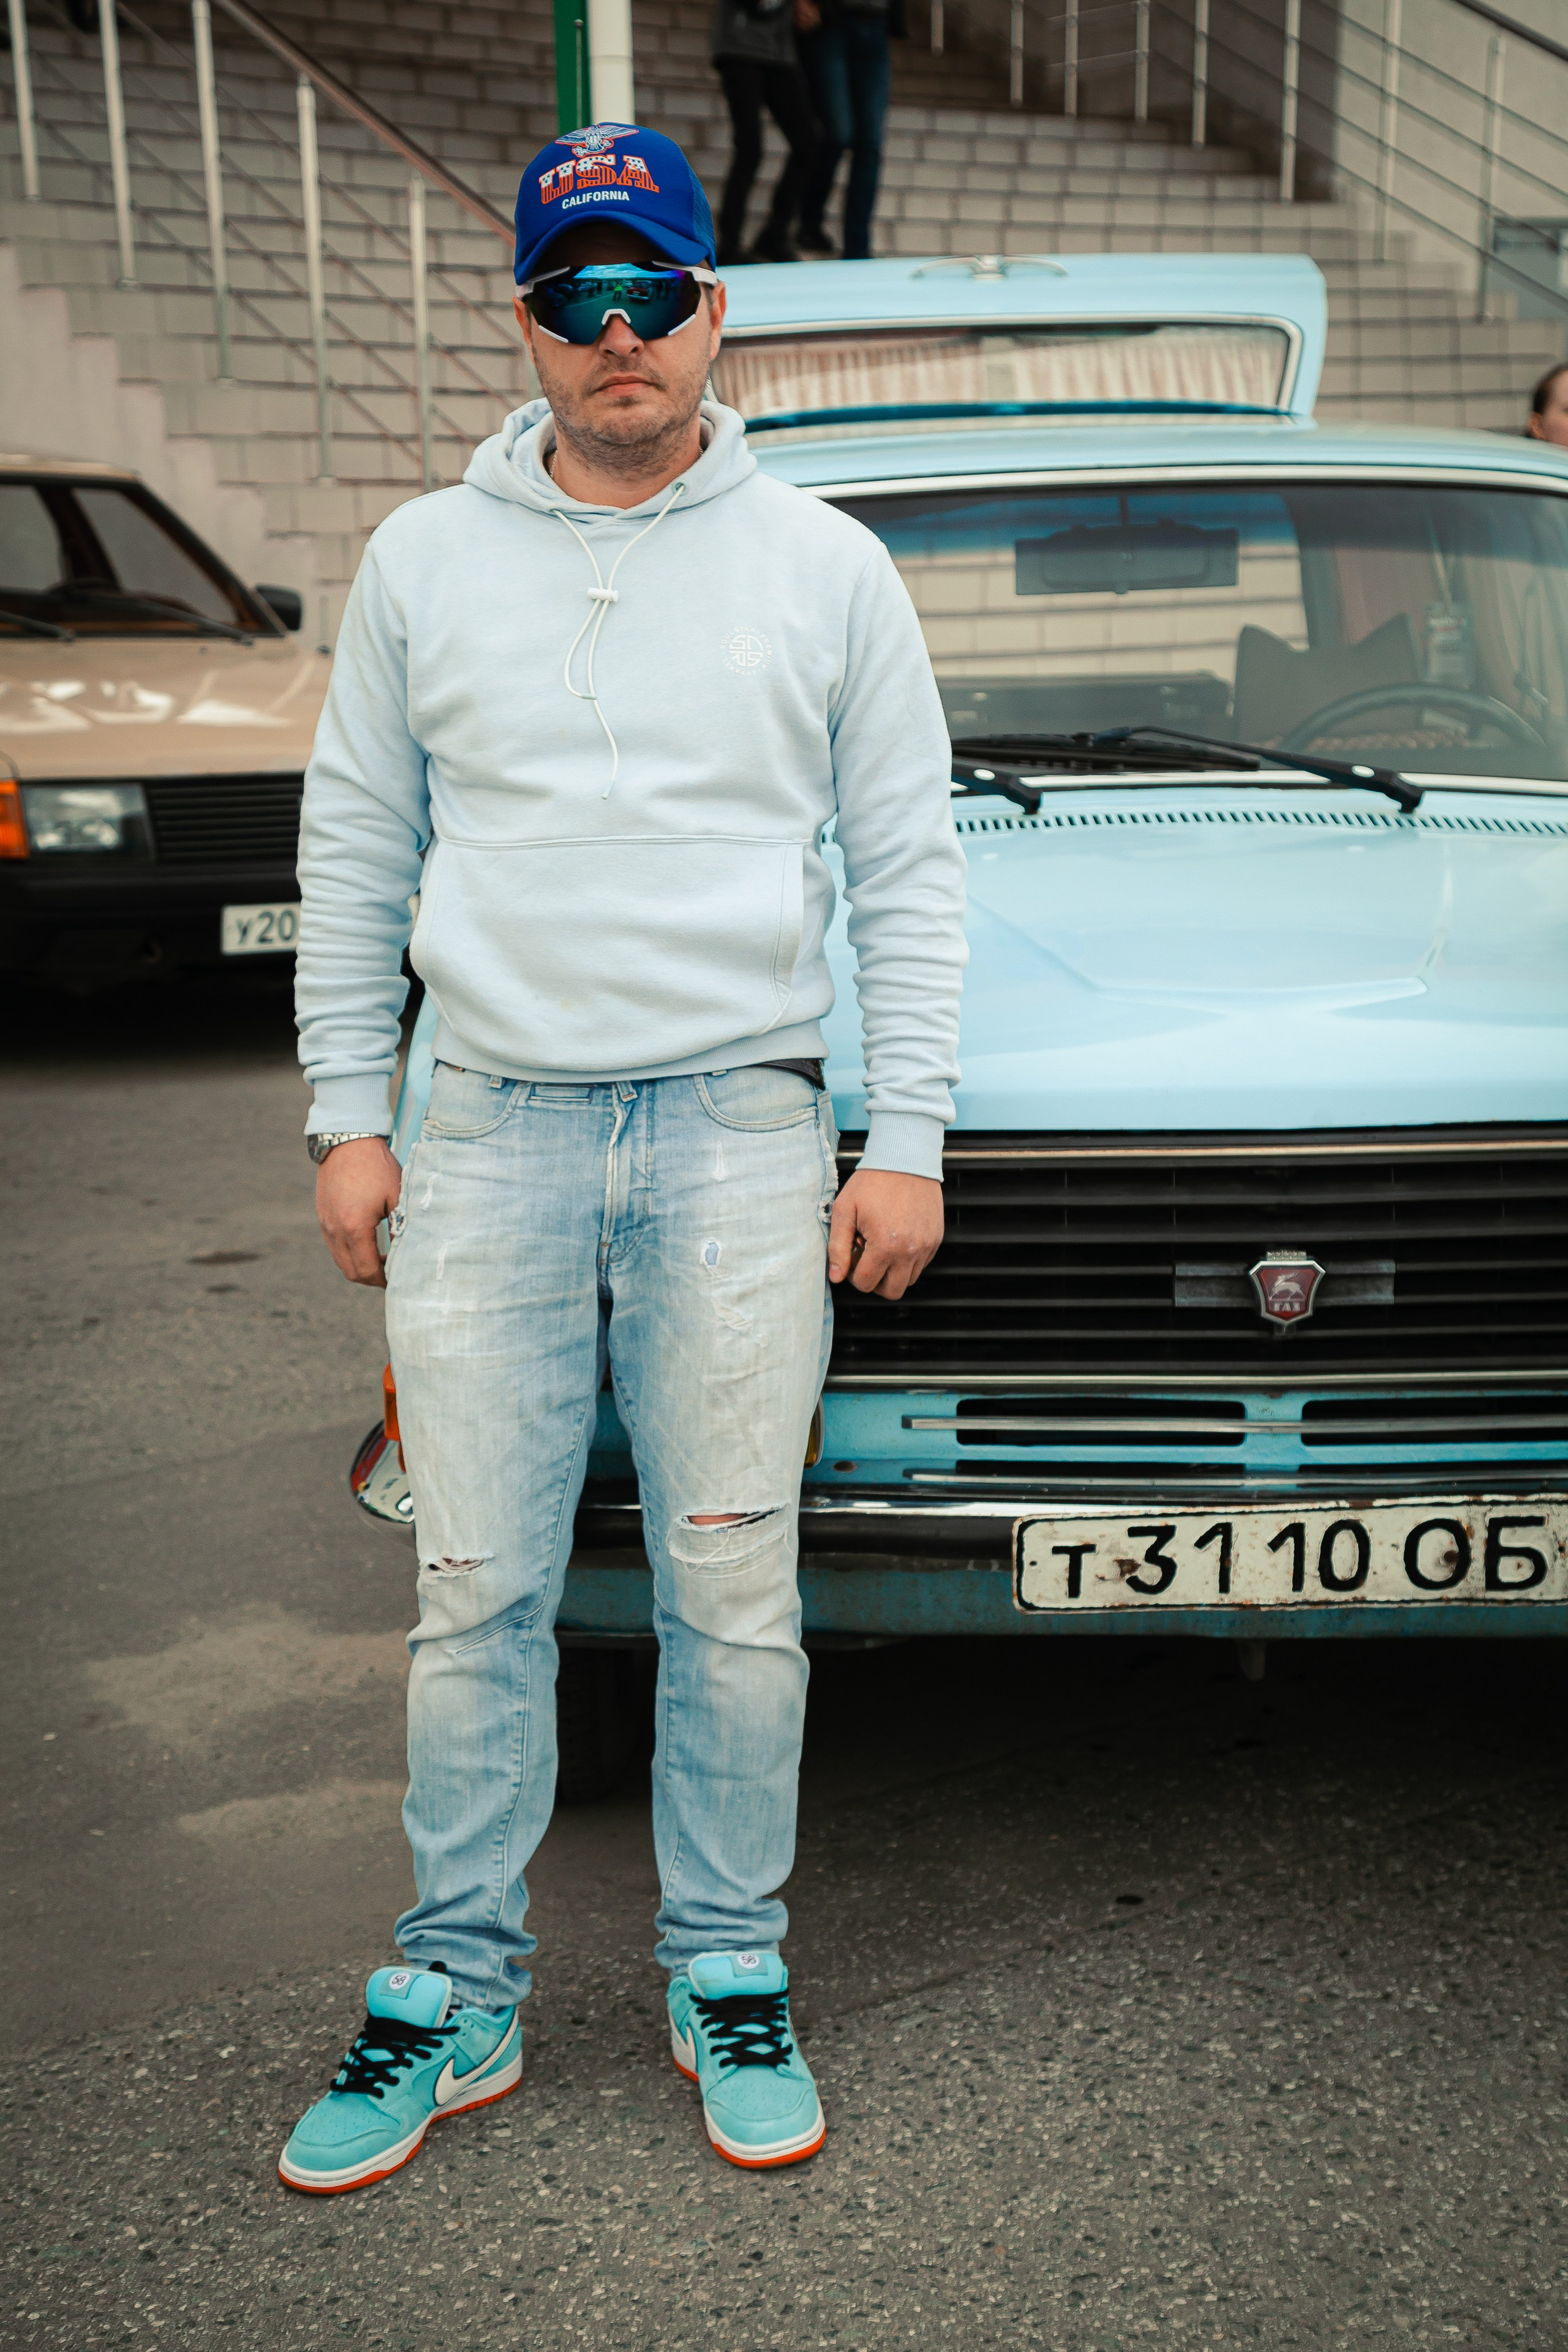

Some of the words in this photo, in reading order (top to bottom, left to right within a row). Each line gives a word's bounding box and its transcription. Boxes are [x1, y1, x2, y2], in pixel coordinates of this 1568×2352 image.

[539, 154, 660, 205] USA
[562, 190, 630, 209] CALIFORNIA
[742, 1956, 756, 1964] 58
[392, 1975, 407, 1985] 58
